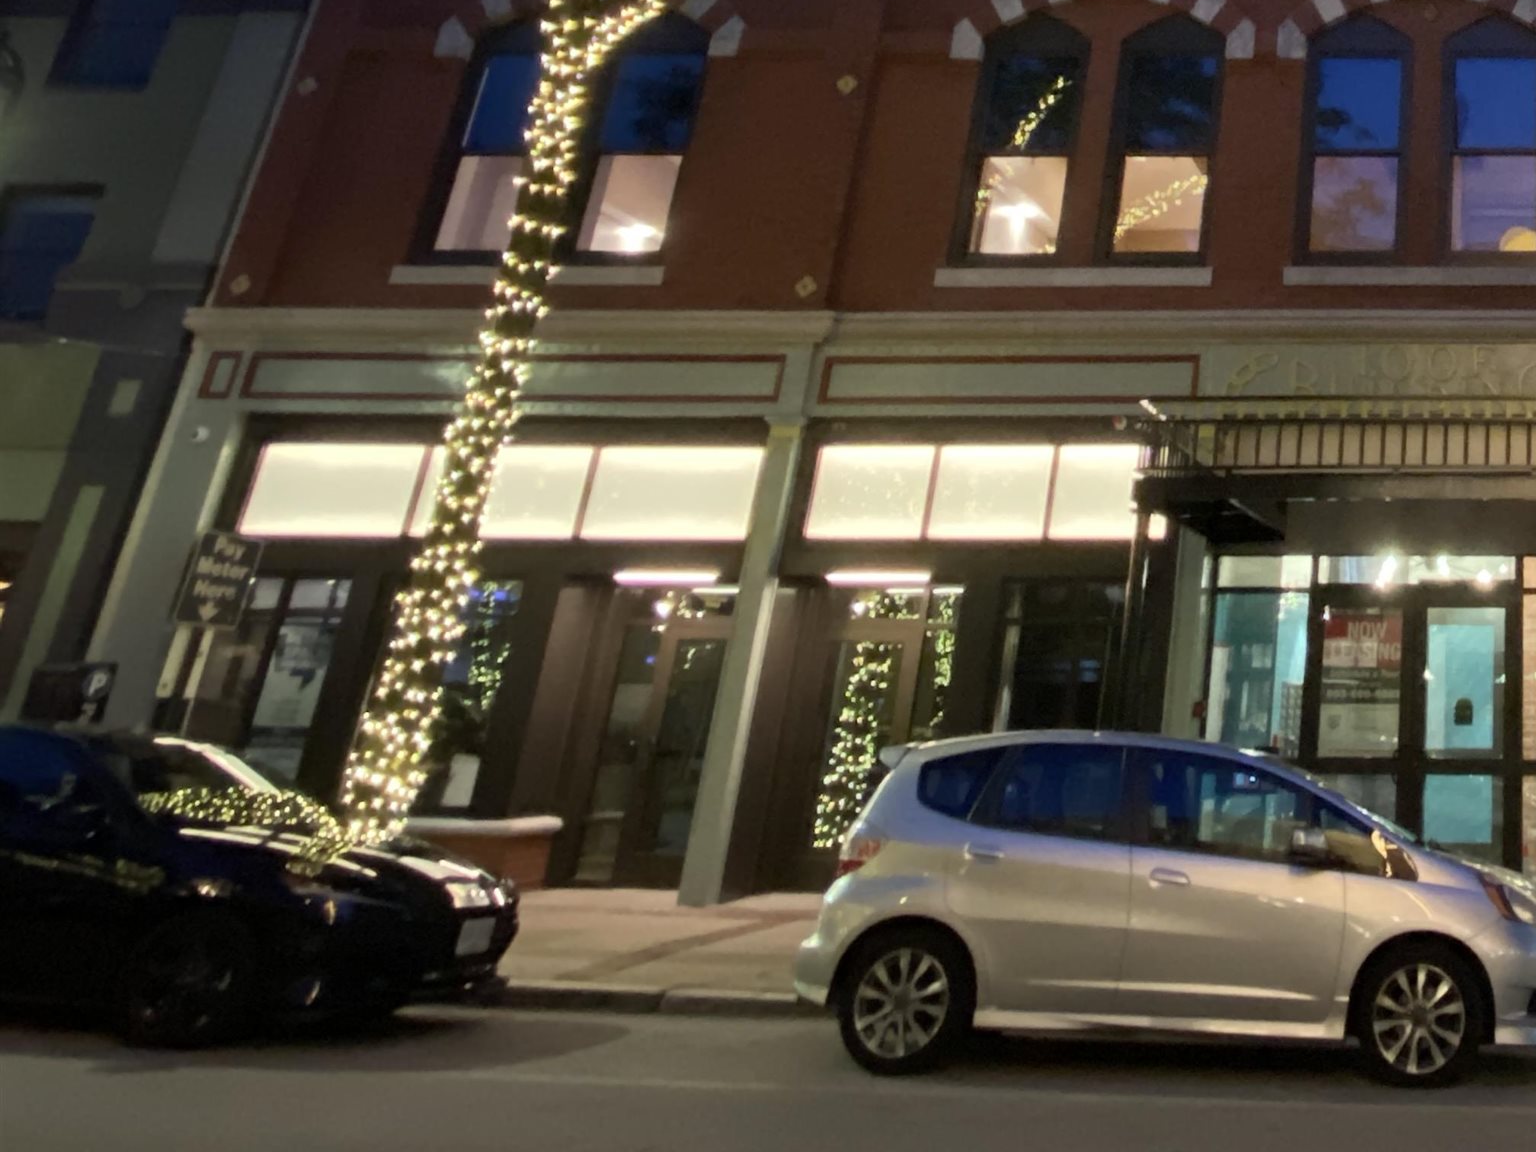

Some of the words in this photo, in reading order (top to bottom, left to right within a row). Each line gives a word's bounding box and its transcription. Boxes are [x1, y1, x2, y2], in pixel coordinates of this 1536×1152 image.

[215, 535, 246, 561] Pay
[197, 555, 249, 580] Meter
[1348, 621, 1388, 640] NOW
